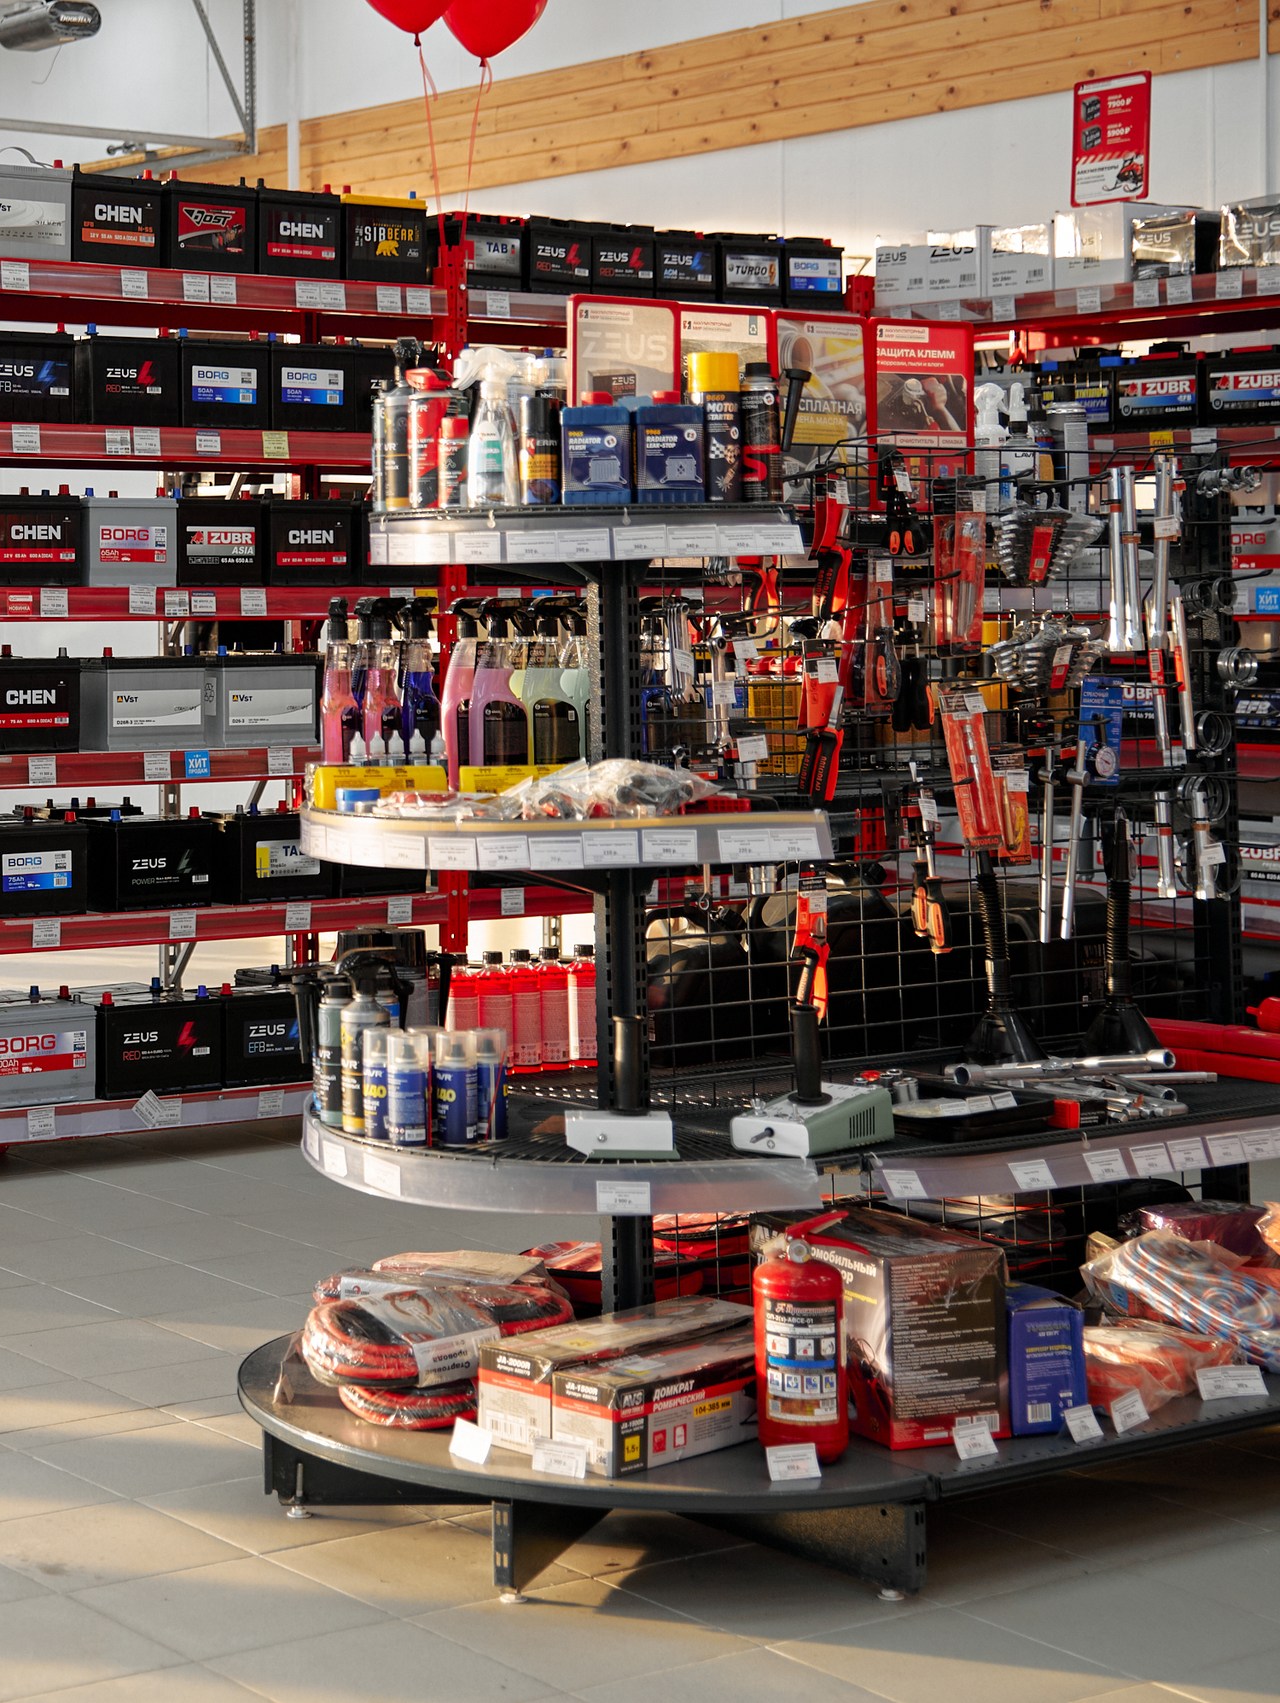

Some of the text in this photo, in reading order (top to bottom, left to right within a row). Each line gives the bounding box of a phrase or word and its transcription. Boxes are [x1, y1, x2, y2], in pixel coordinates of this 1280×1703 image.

[94, 204, 143, 224] CHEN
[279, 221, 324, 239] CHEN
[363, 225, 414, 243] SIBBEAR
[1138, 233, 1171, 245] ZEUS
[485, 241, 509, 255] TAB
[537, 245, 566, 259] ZEUS
[599, 251, 630, 264] ZEUS
[663, 253, 694, 266] ZEUS
[877, 251, 907, 263] ZEUS
[734, 265, 768, 277] TURBO
[793, 261, 820, 272] BORG
[582, 331, 668, 362] ZEUS
[917, 350, 955, 360] КЛЕММ
[106, 367, 138, 379] ZEUS
[197, 370, 230, 380] BORG
[286, 371, 318, 382] BORG
[612, 376, 635, 386] ZEUS
[105, 383, 121, 394] RED
[1146, 380, 1191, 396] ZUBR
[707, 413, 734, 421] STARTER
[816, 417, 843, 426] МАСЛА
[569, 436, 601, 445] RADIATOR
[646, 435, 678, 444] RADIATOR
[899, 437, 935, 445] ОЧИСТИТЕЛЬ
[646, 442, 677, 450] LEAK-STOP
[11, 525, 62, 541] CHEN
[100, 527, 150, 541] BORG
[210, 531, 253, 545] ZUBR
[288, 529, 335, 545] CHEN
[231, 546, 254, 555] ASIA
[1258, 594, 1279, 605] ХИТ
[8, 604, 32, 613] НОВИНКА
[6, 689, 56, 705] CHEN
[188, 758, 208, 768] ХИТ
[8, 856, 42, 867] BORG
[132, 858, 167, 869] ZEUS
[132, 877, 156, 886] POWER
[249, 1024, 286, 1037] ZEUS
[123, 1032, 159, 1045] ZEUS
[248, 1041, 266, 1053] EFB
[123, 1050, 141, 1062] RED
[497, 1356, 531, 1370] JA-2000R
[653, 1380, 695, 1401] ДОМКРАТ
[622, 1392, 643, 1408] AVS
[653, 1389, 706, 1412] РОМБИЧЕСКИЙ
[695, 1402, 720, 1416] 104-385
